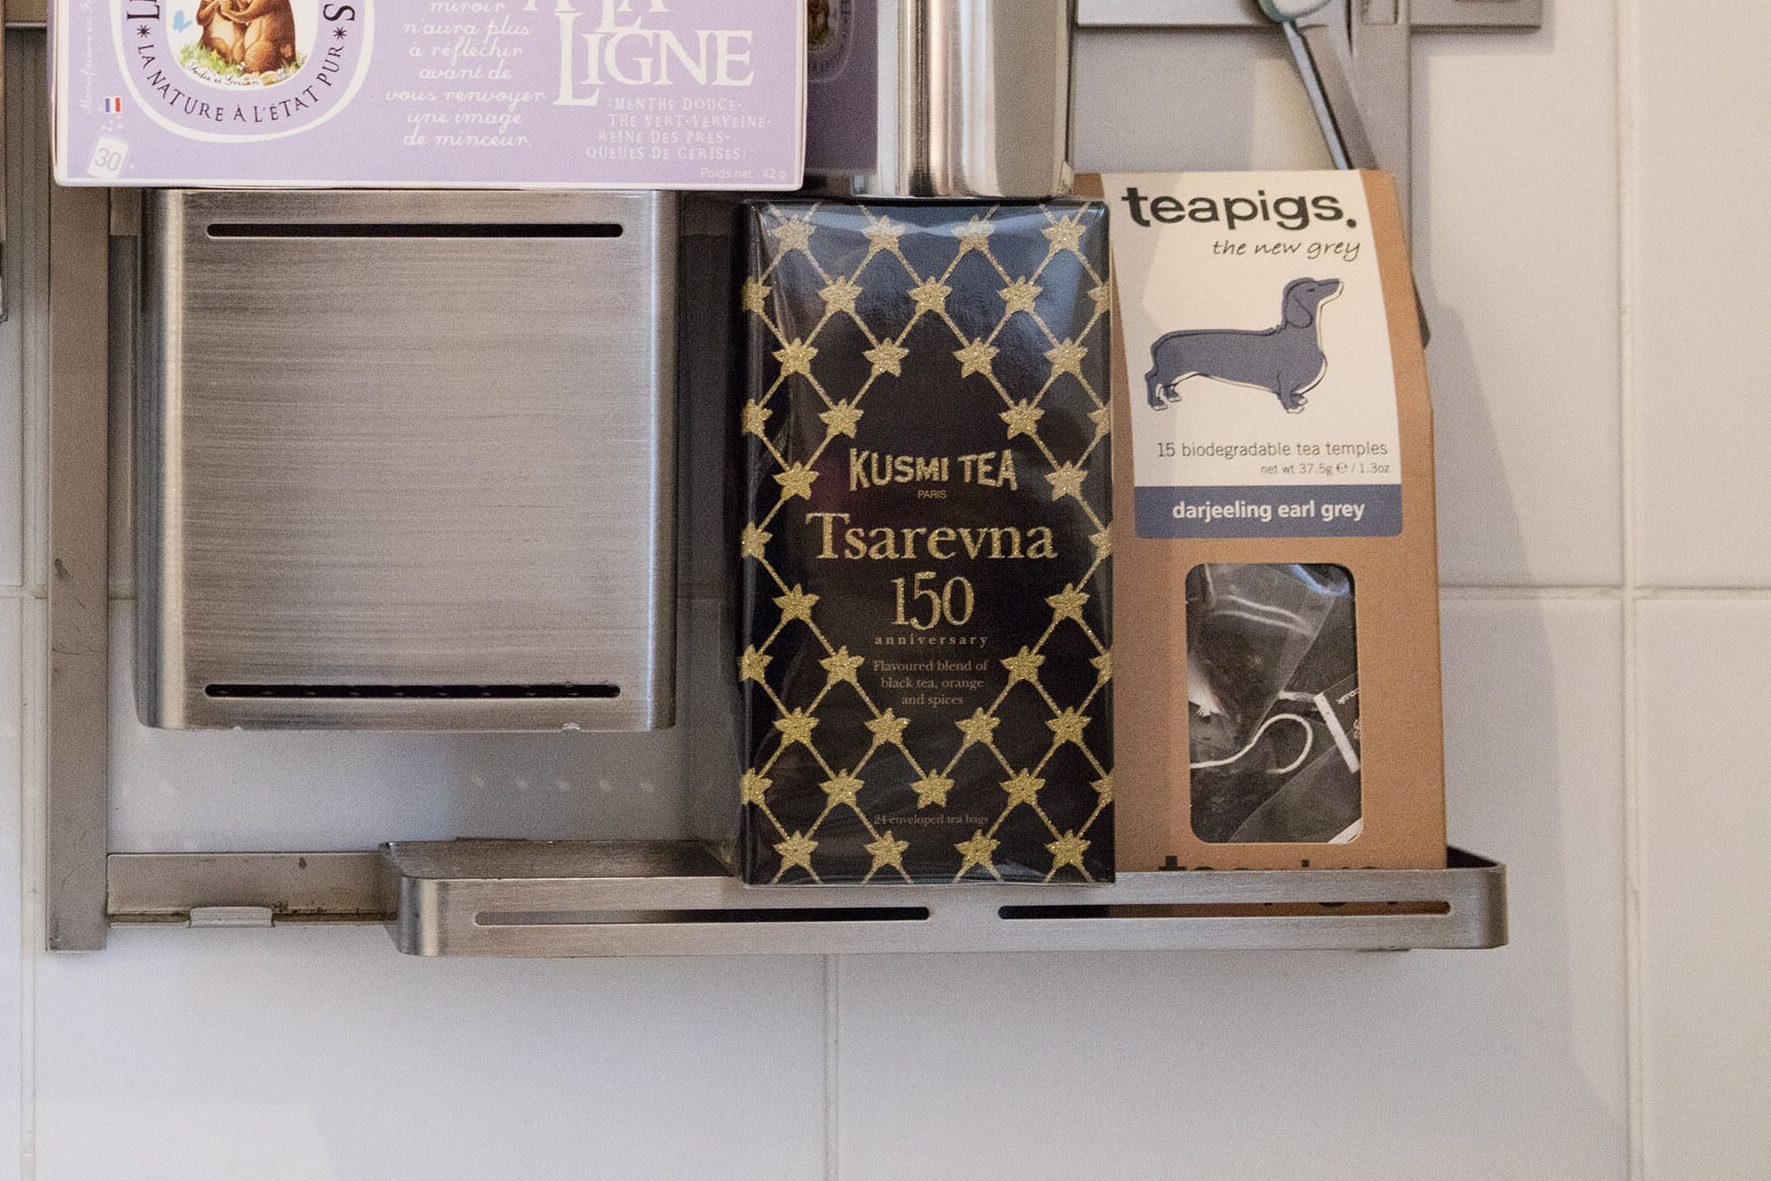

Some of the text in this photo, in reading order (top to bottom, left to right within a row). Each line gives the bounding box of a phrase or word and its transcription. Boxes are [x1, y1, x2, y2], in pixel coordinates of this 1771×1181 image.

[402, 14, 533, 46] n'aura plus
[136, 43, 157, 69] LA
[409, 35, 526, 68] à réfléchir
[552, 11, 756, 107] LIGNE
[316, 45, 345, 87] PUR
[419, 58, 514, 81] avant de
[146, 69, 225, 123] NATURE
[253, 85, 320, 123] L'ÉTAT
[385, 89, 546, 113] vous renvoyer
[232, 98, 247, 123] À
[407, 109, 526, 135] une image
[402, 124, 533, 147] de minceur.
[598, 130, 679, 144] REINE DES
[94, 146, 123, 172] 30
[586, 146, 670, 160] QUEUES DE
[700, 167, 777, 180] Poids net 42
[1120, 186, 1358, 232] teapigs.
[1212, 238, 1362, 263] the new grey
[1157, 440, 1389, 461] 15 biodegradable tea temples
[848, 447, 1018, 492] KUSMI TEA
[1259, 462, 1391, 477] net wt 37.5g 1.3oz
[917, 489, 947, 499] PARIS
[1172, 499, 1366, 524] darjeeling earl grey
[805, 511, 1059, 561] Tsarevna
[890, 571, 975, 631] 150
[874, 633, 989, 649] anniversary
[873, 659, 989, 672] Flavoured blend of
[881, 677, 985, 692] black tea, orange
[901, 693, 964, 709] and spices
[889, 814, 944, 827] enveloped
